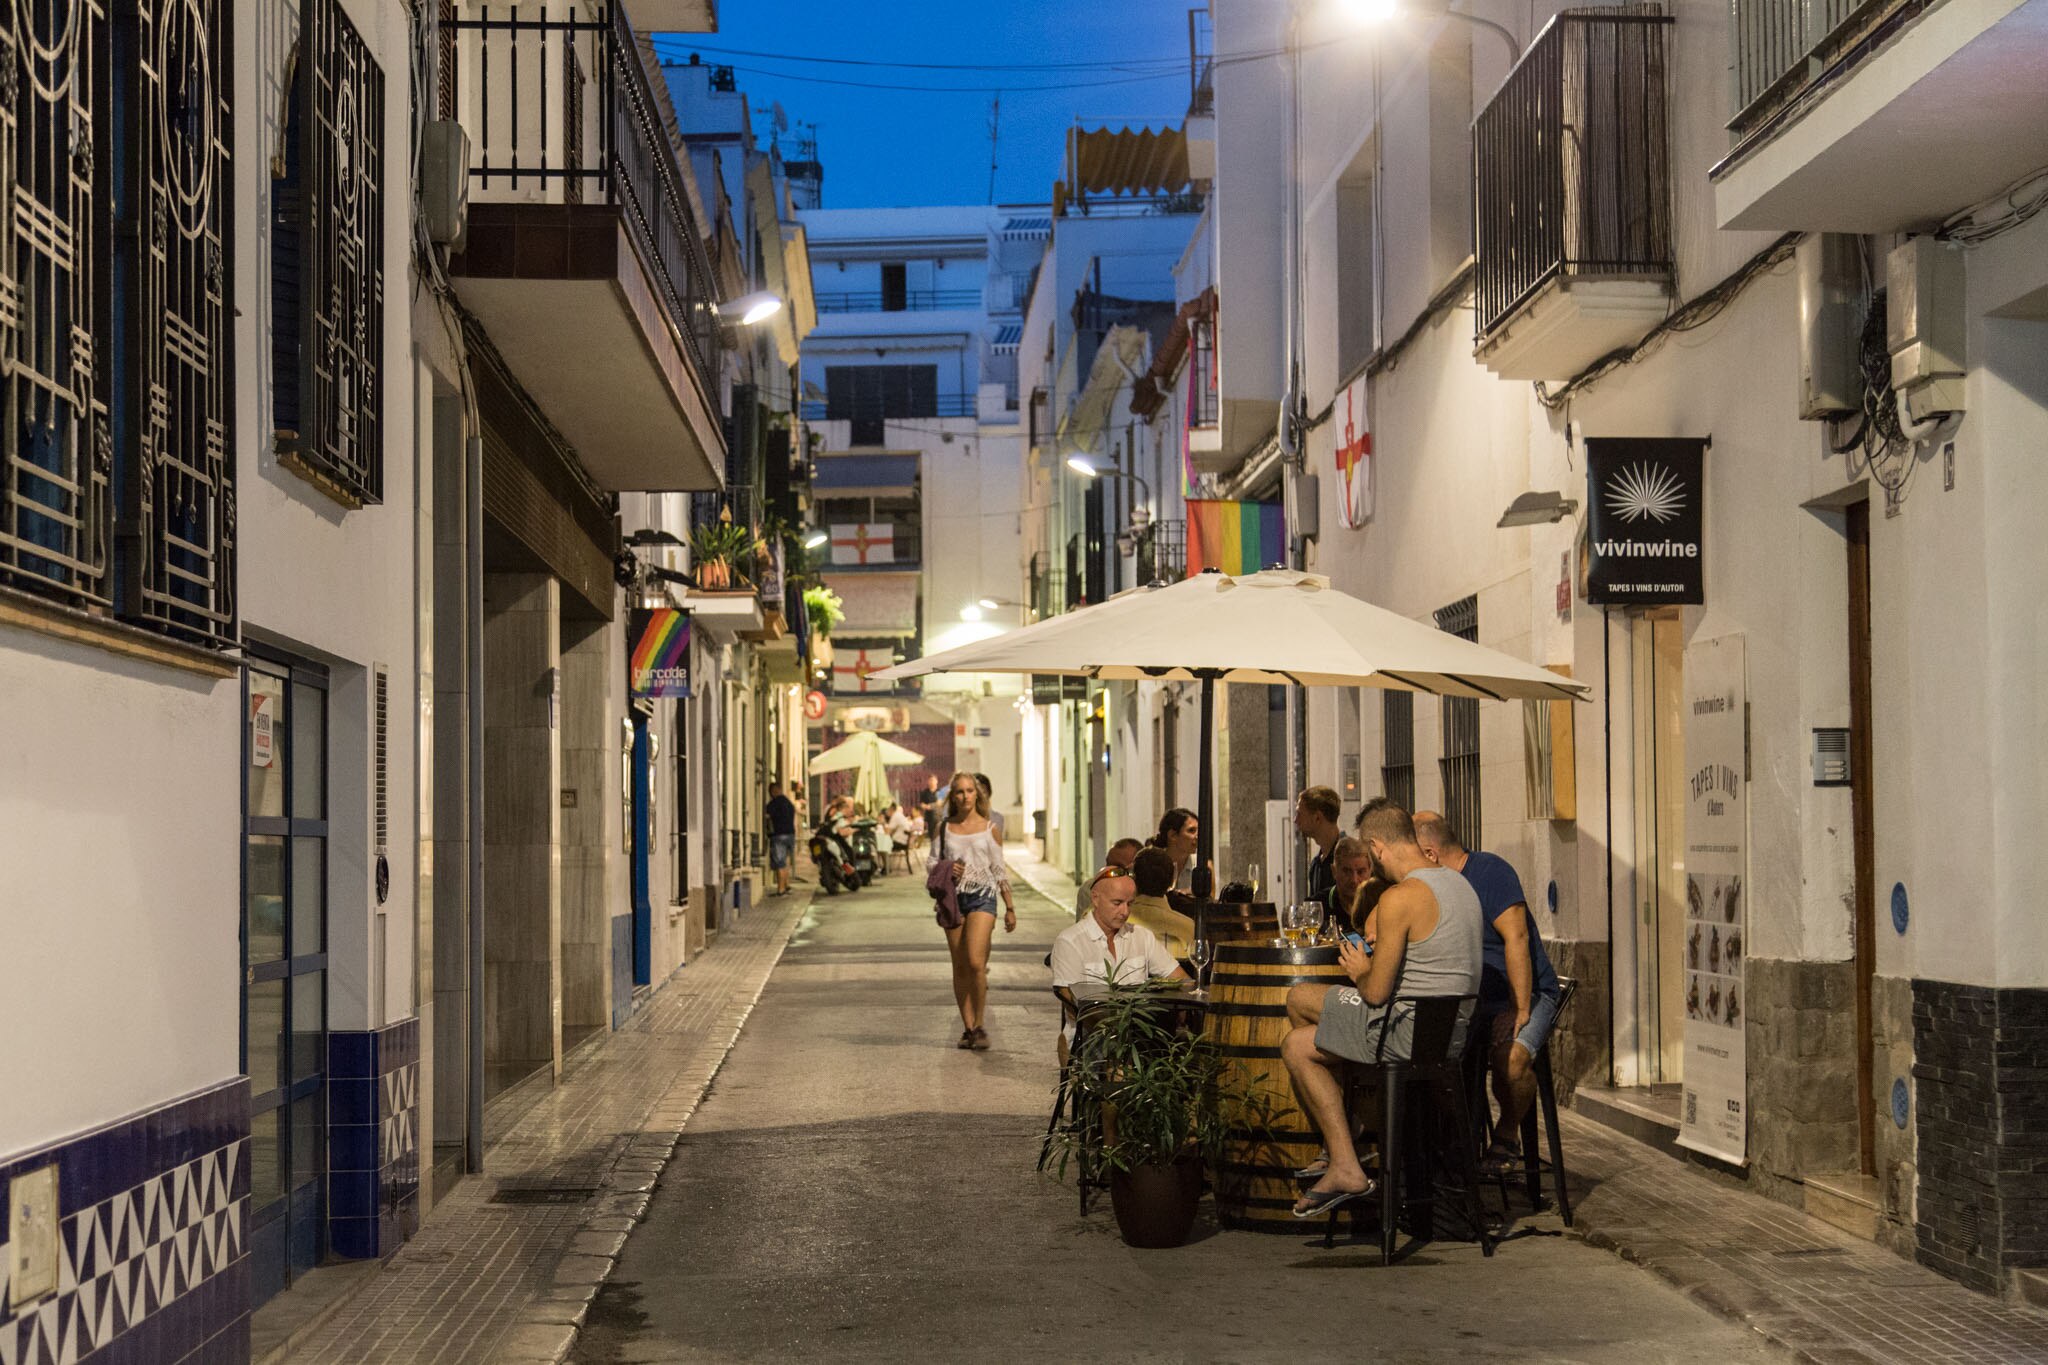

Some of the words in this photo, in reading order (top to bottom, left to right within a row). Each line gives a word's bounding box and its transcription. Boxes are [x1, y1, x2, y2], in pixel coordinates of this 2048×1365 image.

[1594, 539, 1698, 557] vivinwine
[1608, 584, 1630, 592] TAPES
[1631, 584, 1634, 592] I
[1636, 584, 1653, 592] VINS
[1654, 584, 1684, 592] D'AUTOR
[634, 666, 687, 679] barcode
[1693, 696, 1725, 716] vivinwine
[1691, 764, 1714, 803] TAPES
[1716, 763, 1720, 790] I
[1722, 764, 1738, 801] VINS
